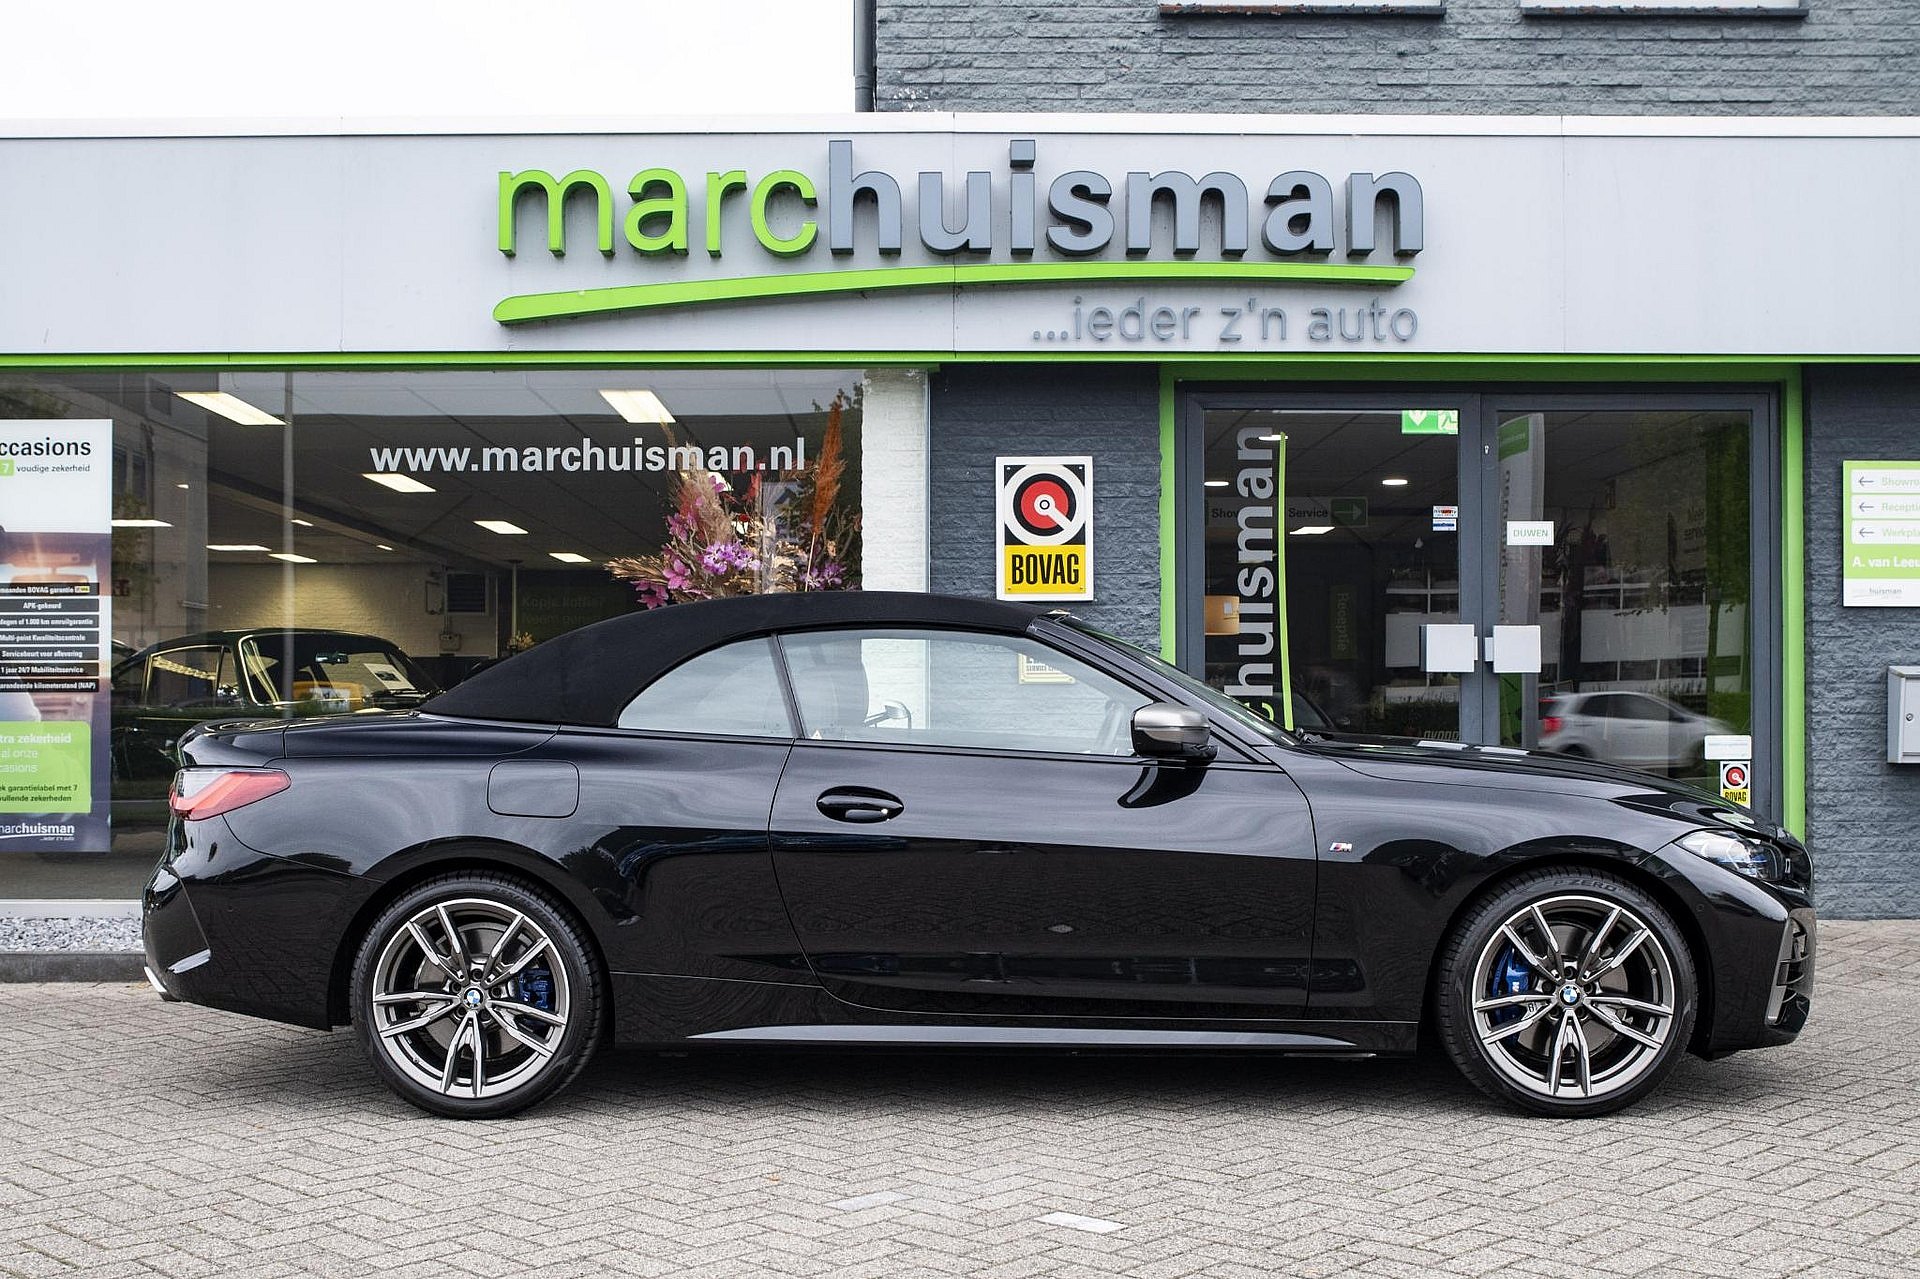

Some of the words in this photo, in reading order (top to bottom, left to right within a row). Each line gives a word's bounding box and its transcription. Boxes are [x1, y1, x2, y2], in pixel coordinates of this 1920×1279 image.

[498, 139, 1424, 257] marchuisman
[1033, 297, 1200, 342] ...ieder
[1220, 298, 1287, 342] z'n
[1307, 298, 1418, 342] auto
[17, 465, 49, 473] voudige
[370, 437, 805, 472] www.marchuisman.nl
[1288, 508, 1328, 518] Service
[1012, 553, 1079, 585] BOVAG
[1868, 558, 1891, 568] van
